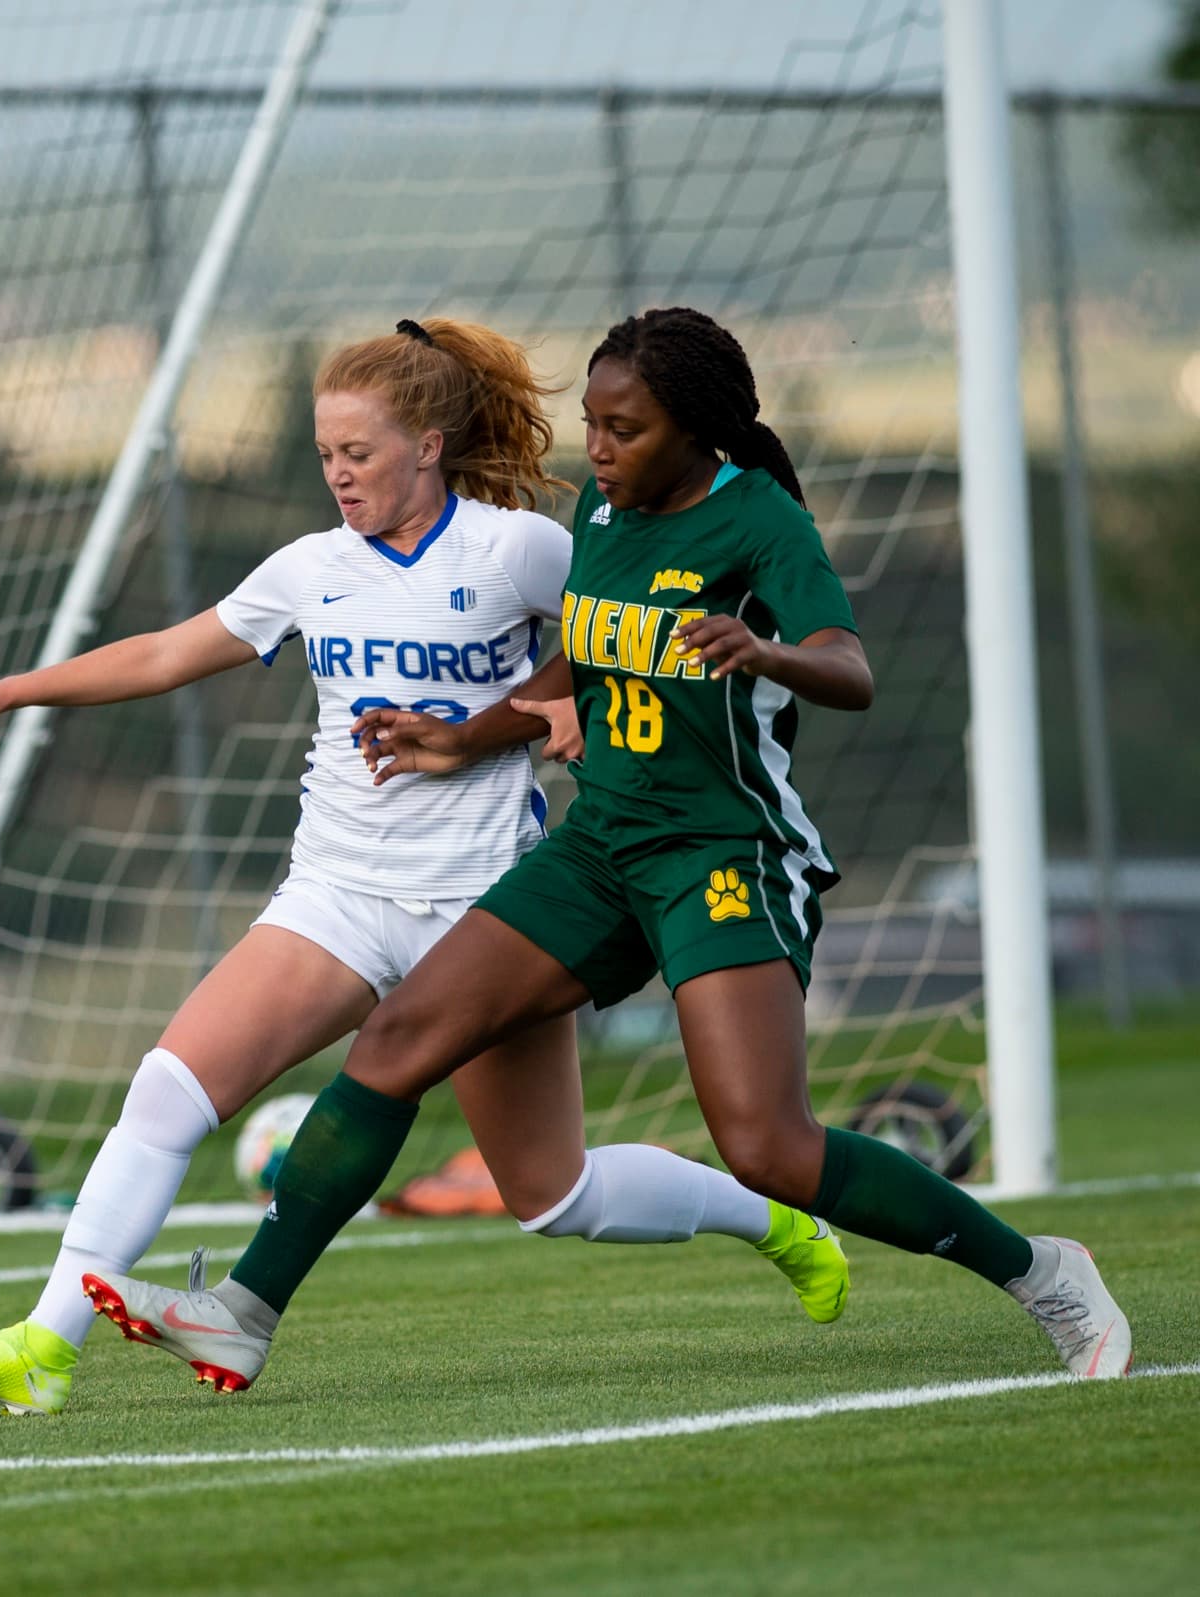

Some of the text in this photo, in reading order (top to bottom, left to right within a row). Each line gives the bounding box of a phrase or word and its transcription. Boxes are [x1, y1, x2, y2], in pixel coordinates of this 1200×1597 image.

[308, 635, 515, 684] AIR FORCE
[604, 675, 664, 754] 18
